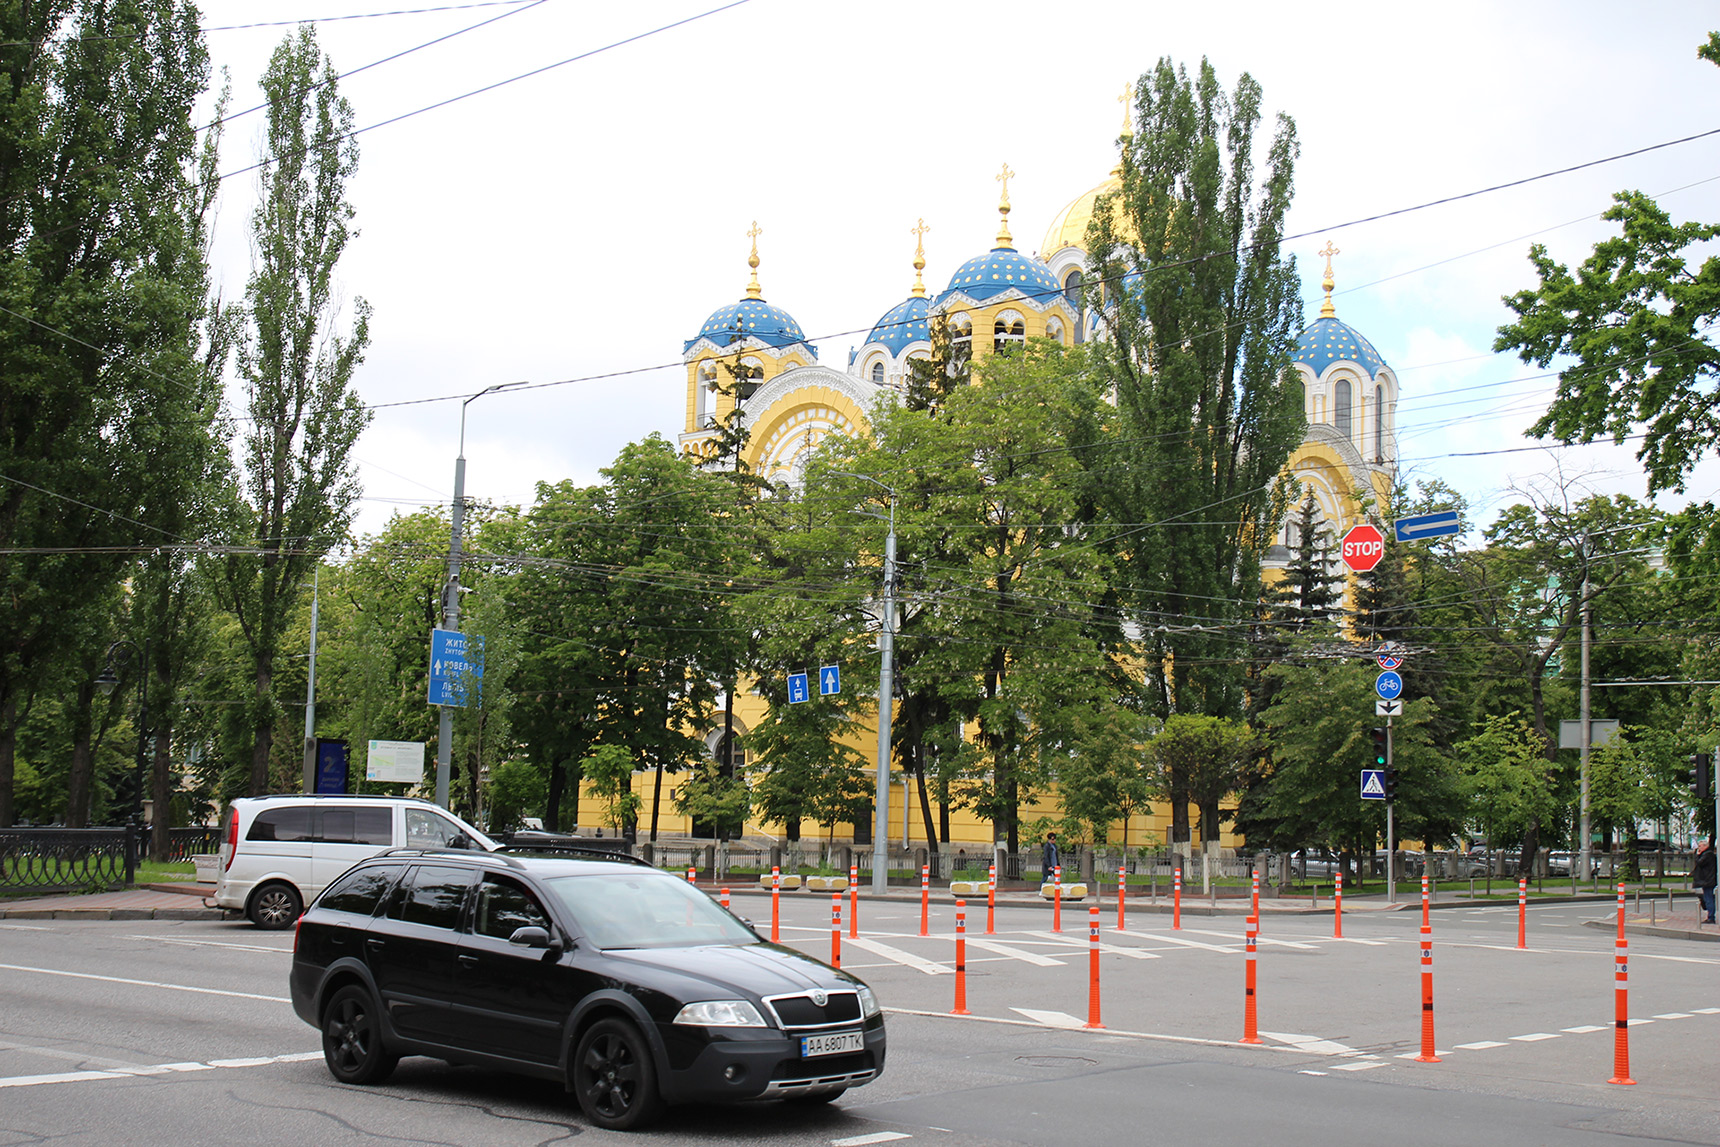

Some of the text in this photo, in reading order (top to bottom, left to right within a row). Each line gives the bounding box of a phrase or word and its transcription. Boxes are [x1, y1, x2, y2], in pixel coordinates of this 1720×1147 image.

[1344, 541, 1382, 557] STOP
[809, 1033, 862, 1054] AA 6807 TK
